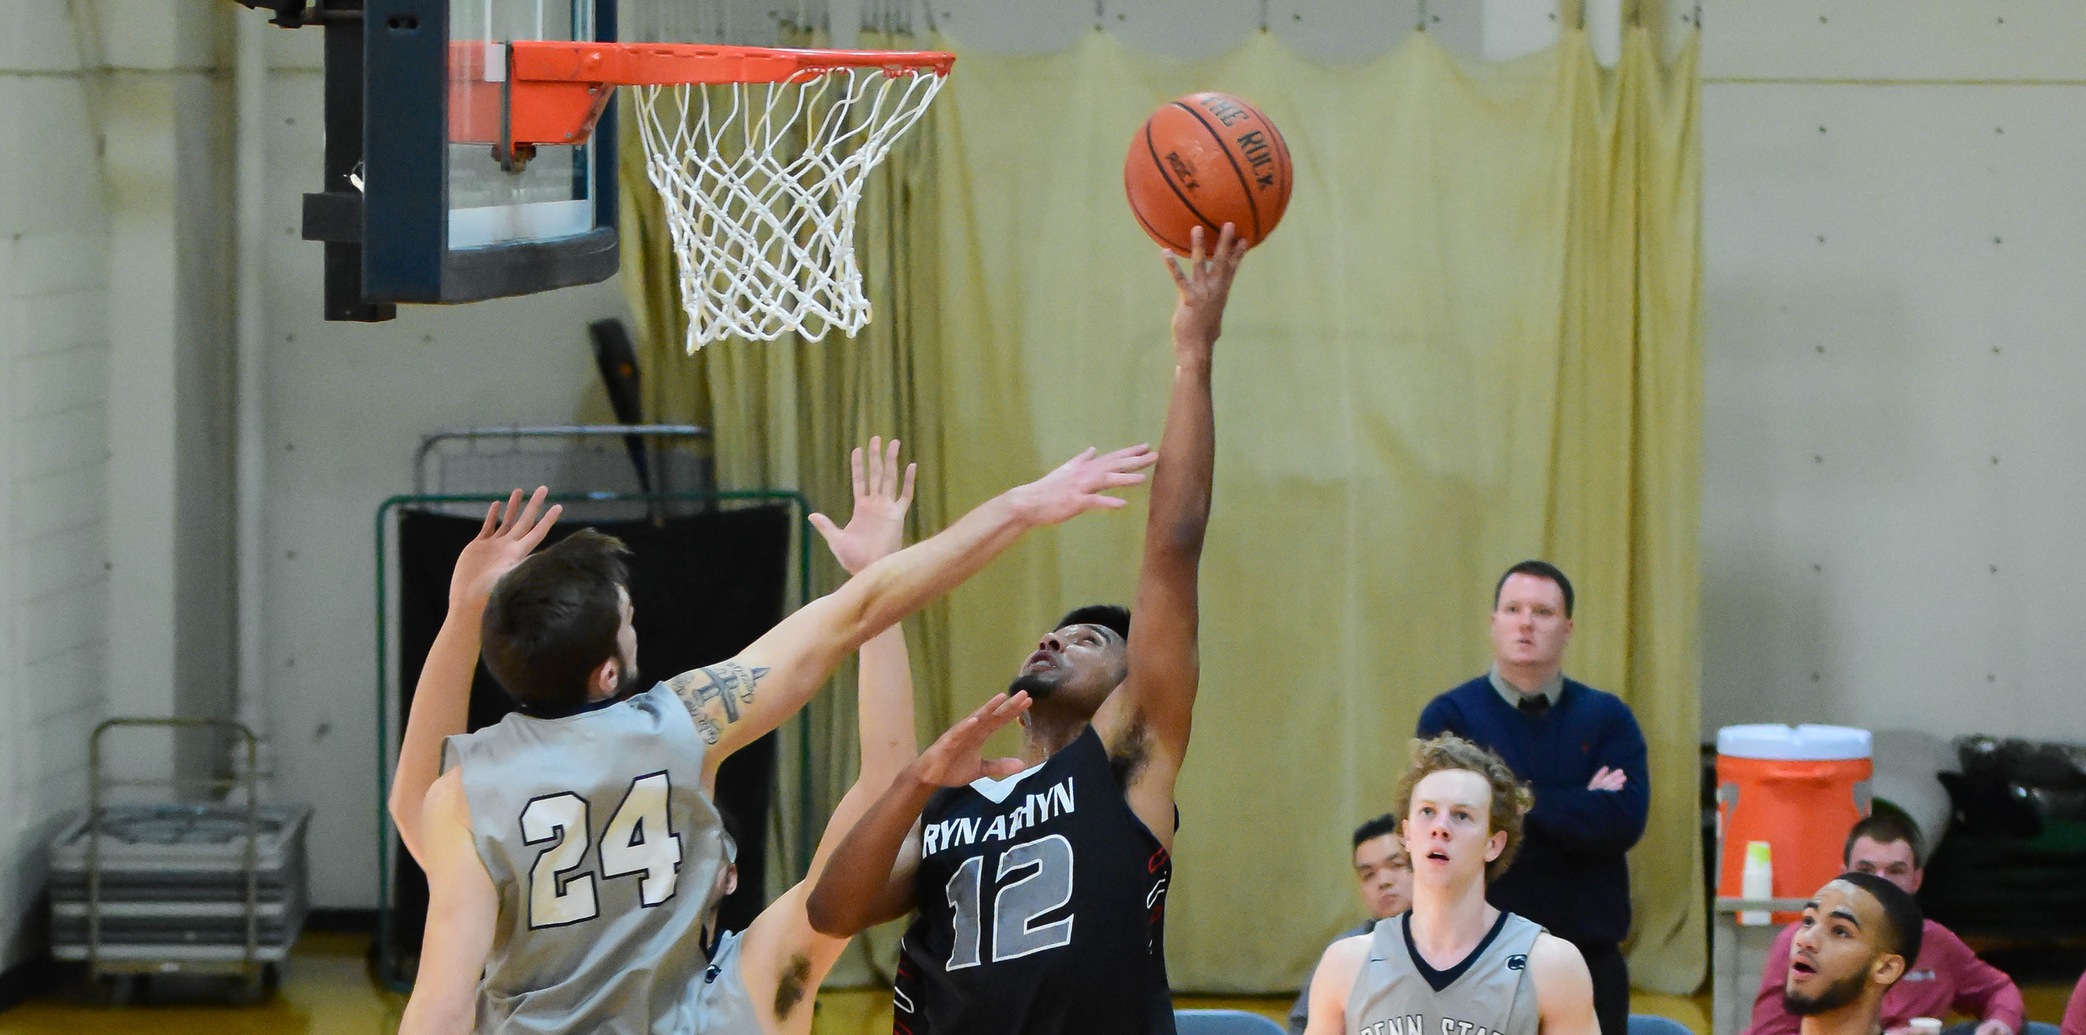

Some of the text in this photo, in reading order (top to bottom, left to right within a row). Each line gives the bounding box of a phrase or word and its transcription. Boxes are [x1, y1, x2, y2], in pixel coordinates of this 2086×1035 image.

[1200, 96, 1274, 191] THE ROCK
[518, 769, 682, 931] 24
[945, 833, 1075, 972] 12
